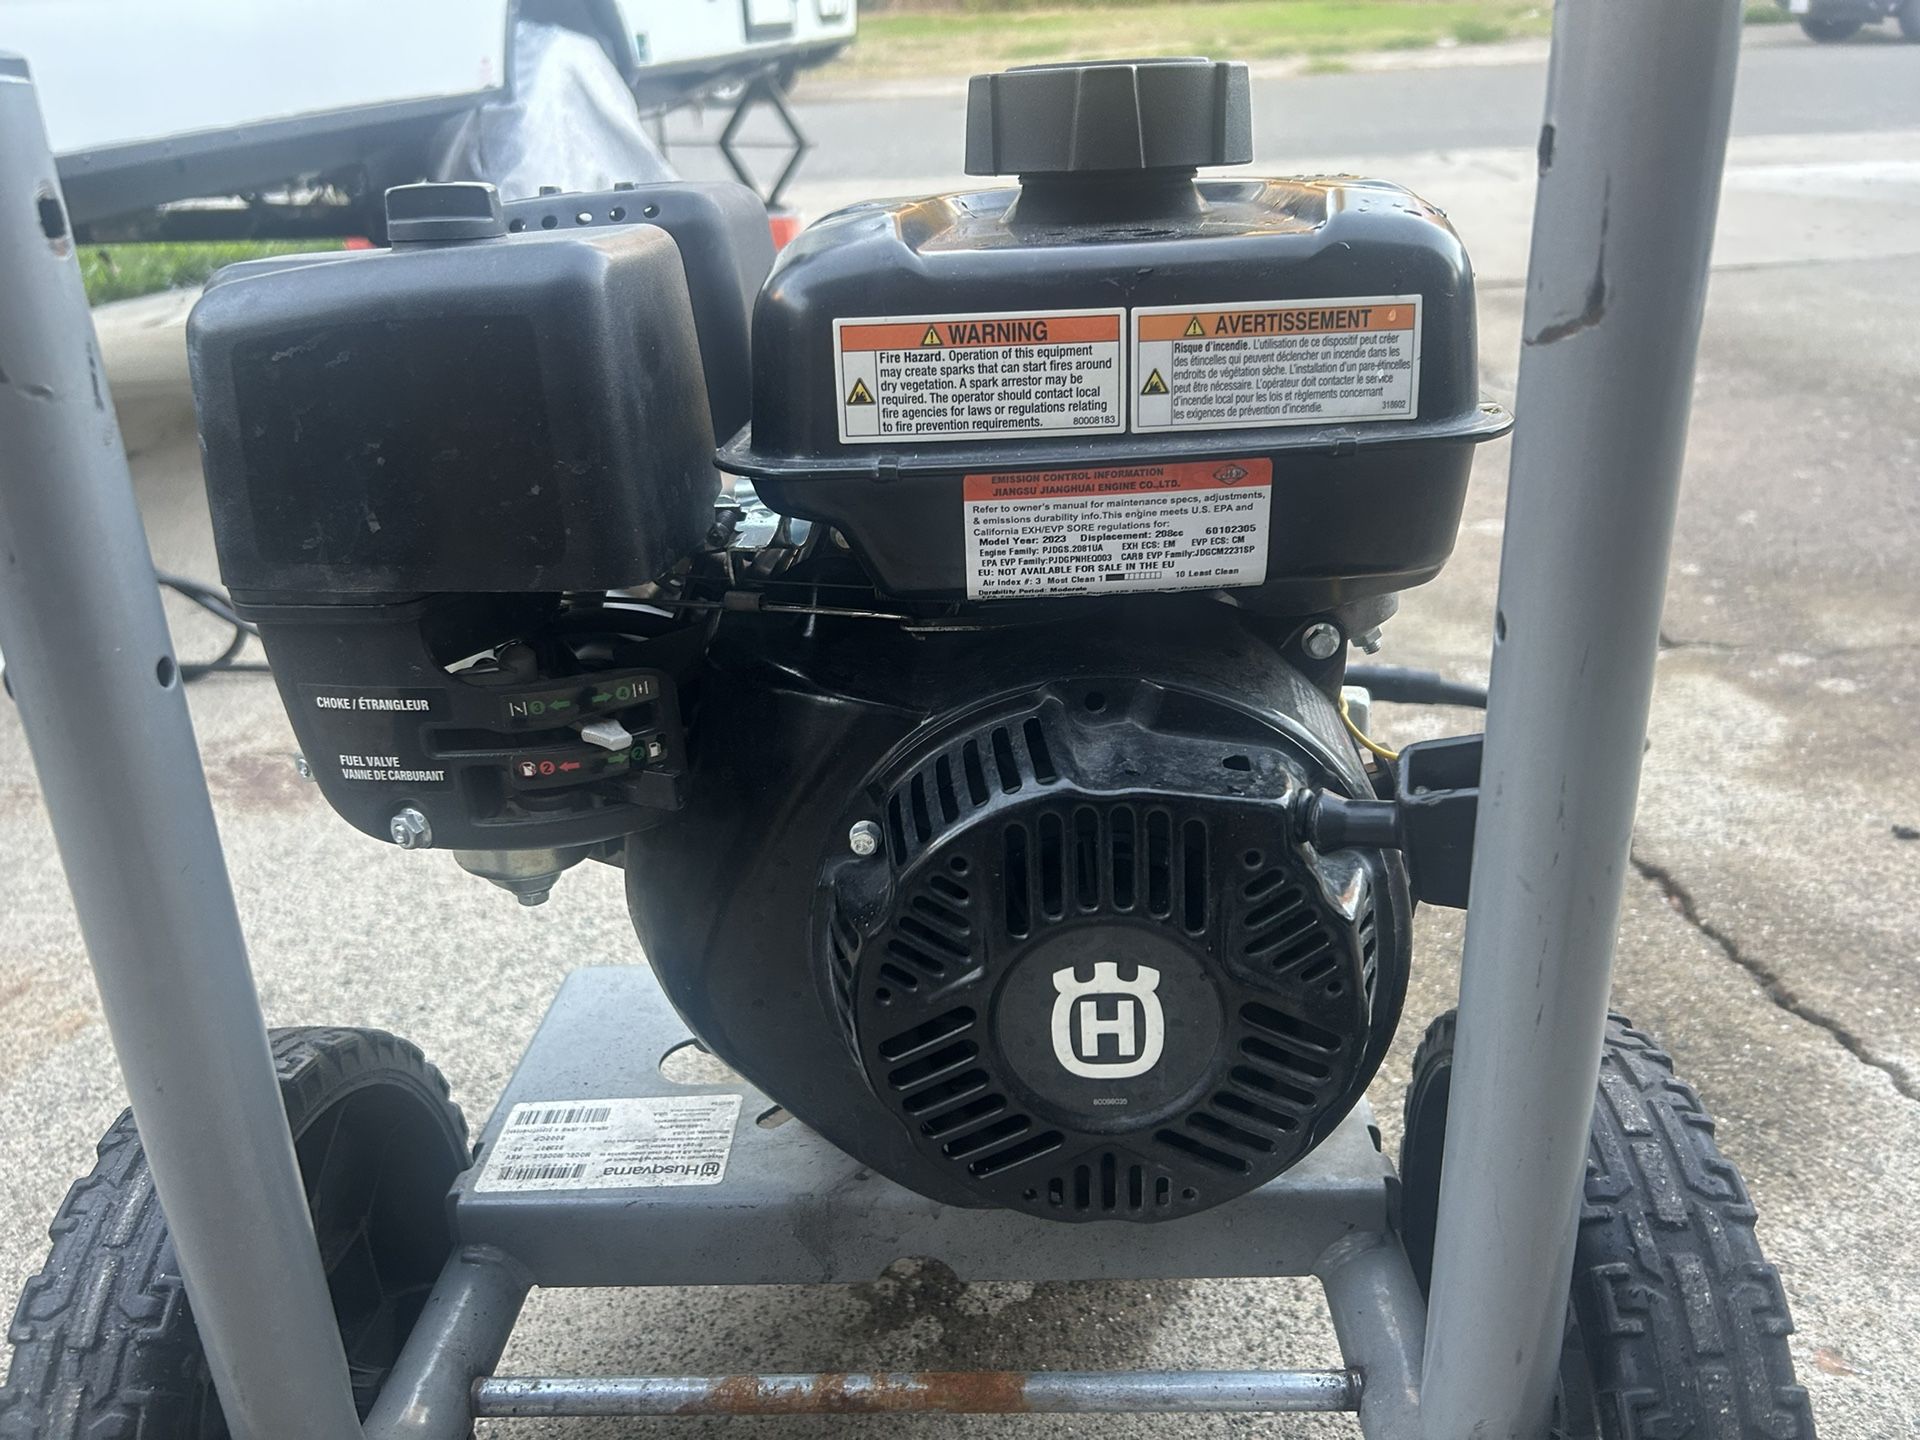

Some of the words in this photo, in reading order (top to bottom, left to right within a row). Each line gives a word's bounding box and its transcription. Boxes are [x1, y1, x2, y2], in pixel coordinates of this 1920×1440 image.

[1215, 309, 1371, 334] AVERTISSEMENT
[948, 321, 1047, 344] WARNING
[1175, 342, 1202, 354] Risque
[1253, 338, 1297, 349] L'utilisation
[1299, 337, 1308, 347] de
[1310, 338, 1320, 347] ce
[1321, 334, 1358, 348] dispositif
[1359, 334, 1377, 347] peut
[1379, 332, 1399, 344] créer
[879, 352, 900, 363] Fire
[904, 350, 944, 362] Hazard.
[948, 349, 998, 363] Operation
[1001, 347, 1012, 359] of
[1014, 347, 1034, 358] this
[1037, 345, 1092, 359] equipment
[1174, 356, 1188, 366] des
[1190, 354, 1226, 366] étincelles
[1228, 353, 1241, 366] qui
[1243, 352, 1274, 365] peuvent
[1276, 350, 1319, 362] déclencher
[1320, 351, 1331, 360] un
[1333, 346, 1366, 359] incendie
[1367, 347, 1386, 358] dans
[1388, 346, 1400, 356] les
[880, 368, 901, 379] may
[904, 365, 936, 376] create
[940, 364, 974, 377] sparks
[977, 362, 998, 374] that
[1001, 363, 1019, 373] can
[1022, 360, 1046, 372] start
[1049, 360, 1072, 370] fires
[1075, 357, 1111, 370] around
[1174, 368, 1206, 380] endroits
[1207, 368, 1217, 378] de
[1289, 362, 1337, 374] L'installation
[1339, 361, 1356, 372] d'un
[880, 380, 897, 393] dry
[900, 378, 956, 392] vegetation.
[959, 377, 966, 388] A
[969, 376, 998, 390] spark
[1001, 375, 1042, 387] arrestor
[1045, 375, 1066, 387] may
[1070, 373, 1082, 384] be
[1174, 382, 1190, 395] peut
[1256, 377, 1299, 390] L'opérateur
[1301, 376, 1316, 387] doit
[1318, 375, 1354, 386] contacter
[1365, 374, 1393, 384] service
[881, 393, 926, 406] required.
[929, 392, 948, 403] The
[951, 391, 994, 404] operator
[997, 388, 1031, 401] should
[1034, 387, 1072, 399] contact
[1076, 386, 1100, 397] local
[1174, 394, 1213, 406] d'incendie
[1215, 393, 1233, 404] local
[1235, 394, 1254, 405] pour
[1255, 391, 1266, 402] les
[1269, 391, 1282, 401] lois
[1339, 386, 1383, 398] concernant
[882, 408, 898, 418] fire
[902, 406, 947, 420] agencies
[950, 405, 964, 416] for
[968, 405, 991, 415] laws
[994, 406, 1005, 414] or
[1008, 402, 1065, 416] regulations
[1068, 399, 1106, 412] relating
[1174, 409, 1184, 419] les
[1186, 408, 1225, 420] exigences
[1227, 406, 1237, 416] de
[1239, 404, 1279, 418] prévention
[882, 421, 892, 432] to
[895, 421, 912, 431] fire
[915, 419, 968, 434] prevention
[972, 416, 1042, 432] requirements.
[1073, 415, 1115, 425] 80008183
[991, 474, 1039, 484] EMISSION
[1043, 472, 1091, 481] CONTROL
[1093, 467, 1163, 479] INFORMATION
[992, 486, 1036, 496] JIANGSU
[1098, 481, 1136, 491] ENGINE
[972, 505, 997, 513] Refer
[1012, 503, 1049, 511] owner's
[1053, 501, 1087, 509] manual
[1090, 500, 1103, 508] for
[1106, 498, 1167, 507] maintenance
[1170, 496, 1200, 505] specs,
[1204, 491, 1265, 503] adjustments,
[983, 516, 1030, 524] emissions
[1034, 513, 1078, 522] durability
[1125, 509, 1157, 518] engine
[1160, 507, 1188, 516] meets
[1213, 504, 1233, 512] EPA
[1235, 502, 1253, 511] and
[973, 527, 1018, 536] California
[1021, 524, 1064, 534] EXH/EVP
[1066, 523, 1094, 532] SORE
[1097, 521, 1150, 532] regulations
[979, 537, 1008, 545] Model
[1042, 534, 1066, 543] 2023
[1080, 531, 1151, 541] Displacement:
[1205, 524, 1256, 534] 60102305
[979, 549, 1006, 557] Engine
[1009, 547, 1038, 555] Family:
[1122, 542, 1137, 550] EXH
[1141, 541, 1159, 549] ECS:
[1191, 538, 1207, 546] EVP
[1210, 536, 1228, 545] ECS:
[1231, 535, 1244, 543] CM
[1000, 558, 1015, 566] EVP
[1121, 552, 1143, 560] CARB
[1146, 551, 1162, 559] EVP
[1020, 565, 1071, 575] AVAILABLE
[1098, 563, 1121, 571] SALE
[1126, 562, 1135, 570] IN
[1139, 561, 1157, 569] THE
[1162, 560, 1174, 568] EU
[316, 696, 349, 709] CHOKE
[352, 699, 356, 710] /
[358, 696, 430, 711] ÉTRANGLEUR
[339, 754, 365, 766] FUEL
[366, 756, 400, 767] VALVE
[342, 769, 373, 780] VANNE
[374, 770, 387, 780] DE
[388, 770, 444, 781] CARBURANT
[602, 1164, 700, 1178] Husqvarna
